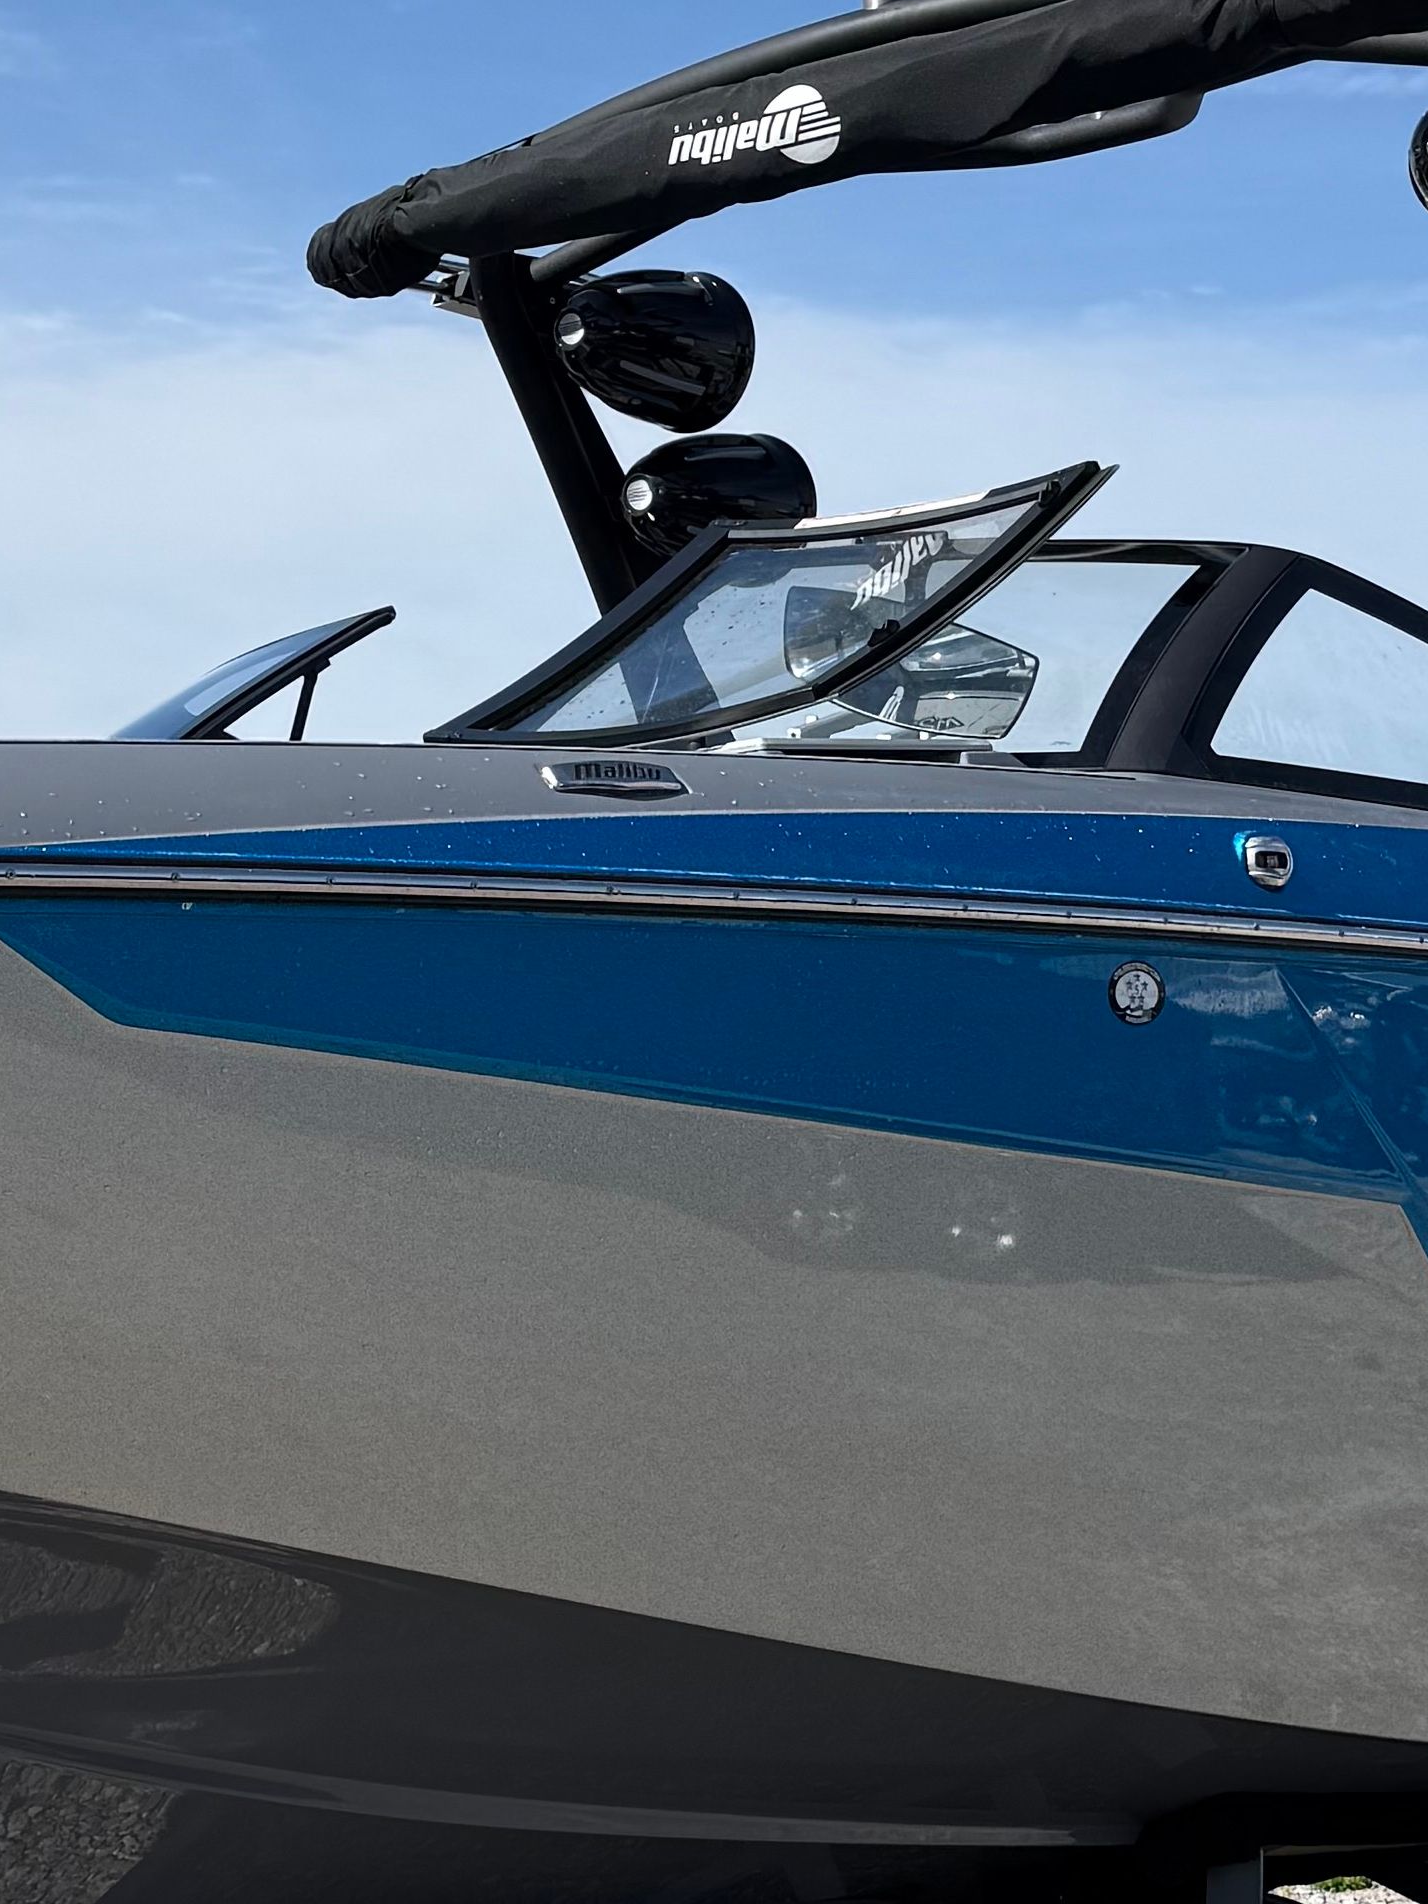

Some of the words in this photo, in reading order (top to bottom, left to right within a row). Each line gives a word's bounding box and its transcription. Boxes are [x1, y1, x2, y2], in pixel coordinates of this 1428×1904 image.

[674, 111, 740, 134] BOATS
[668, 107, 802, 166] Malibu
[574, 762, 661, 781] Malibu
